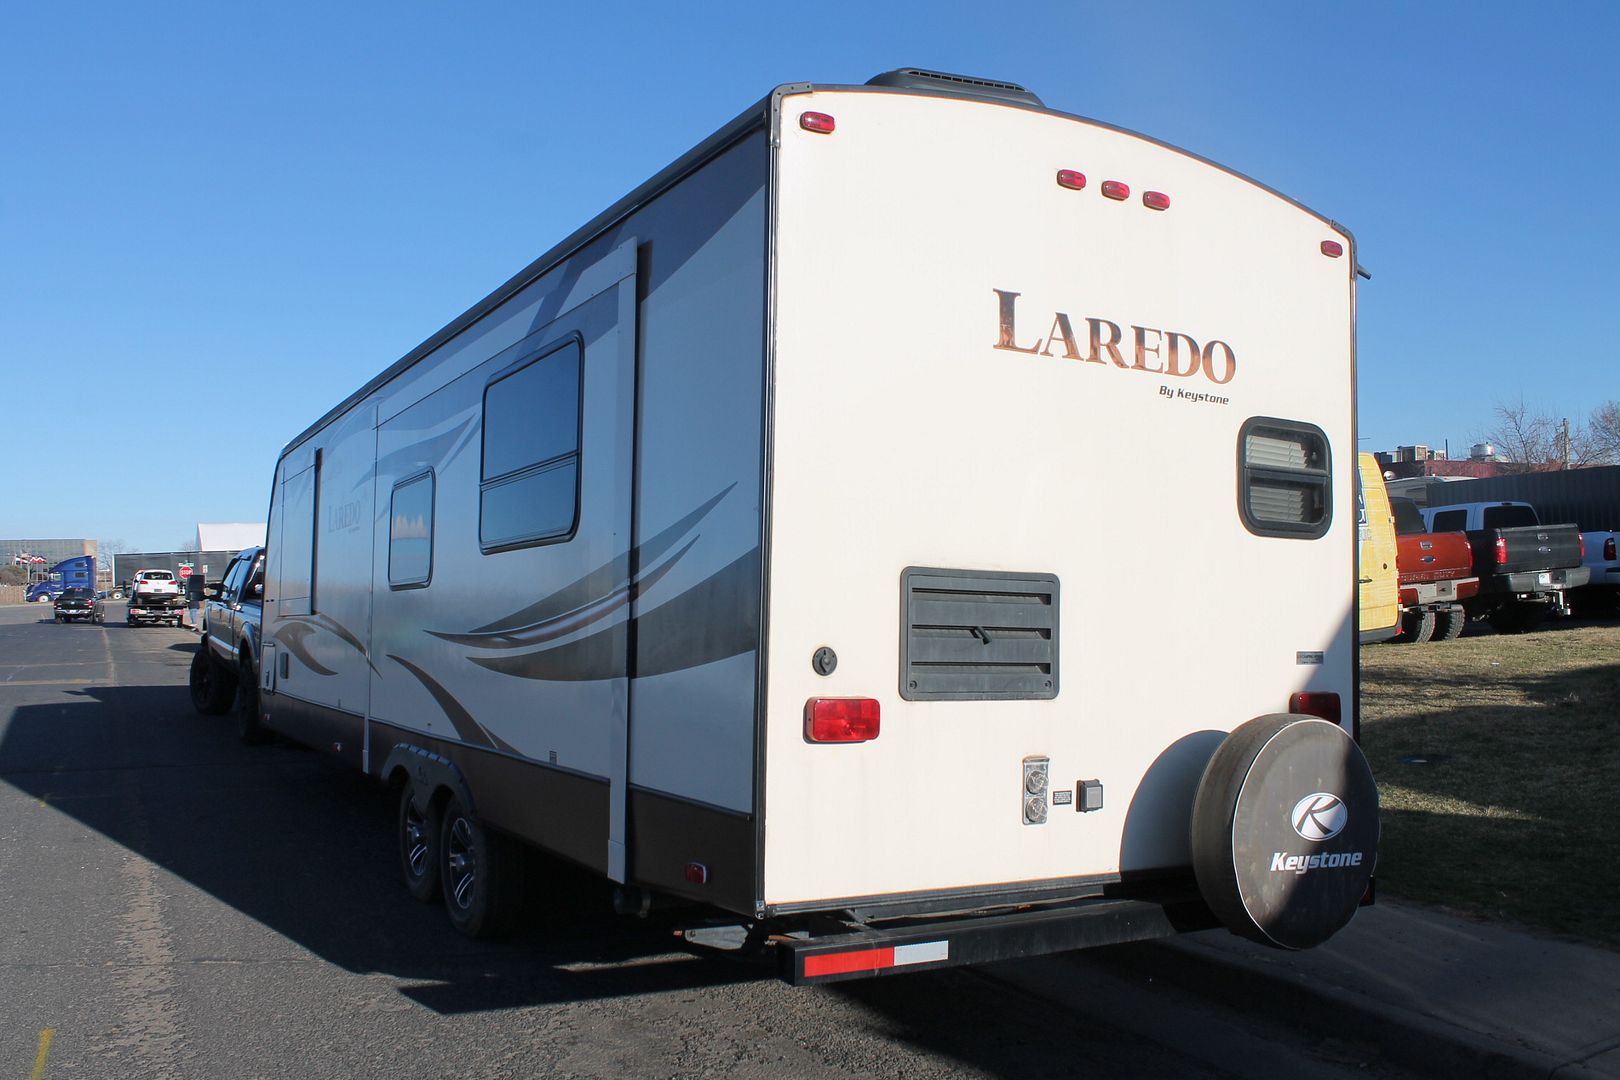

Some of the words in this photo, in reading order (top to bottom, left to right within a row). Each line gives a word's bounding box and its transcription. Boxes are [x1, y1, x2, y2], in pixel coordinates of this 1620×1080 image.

[993, 288, 1236, 384] LAREDO
[1159, 385, 1174, 399] By
[1177, 388, 1229, 405] Keystone
[1270, 852, 1362, 875] Keystone
